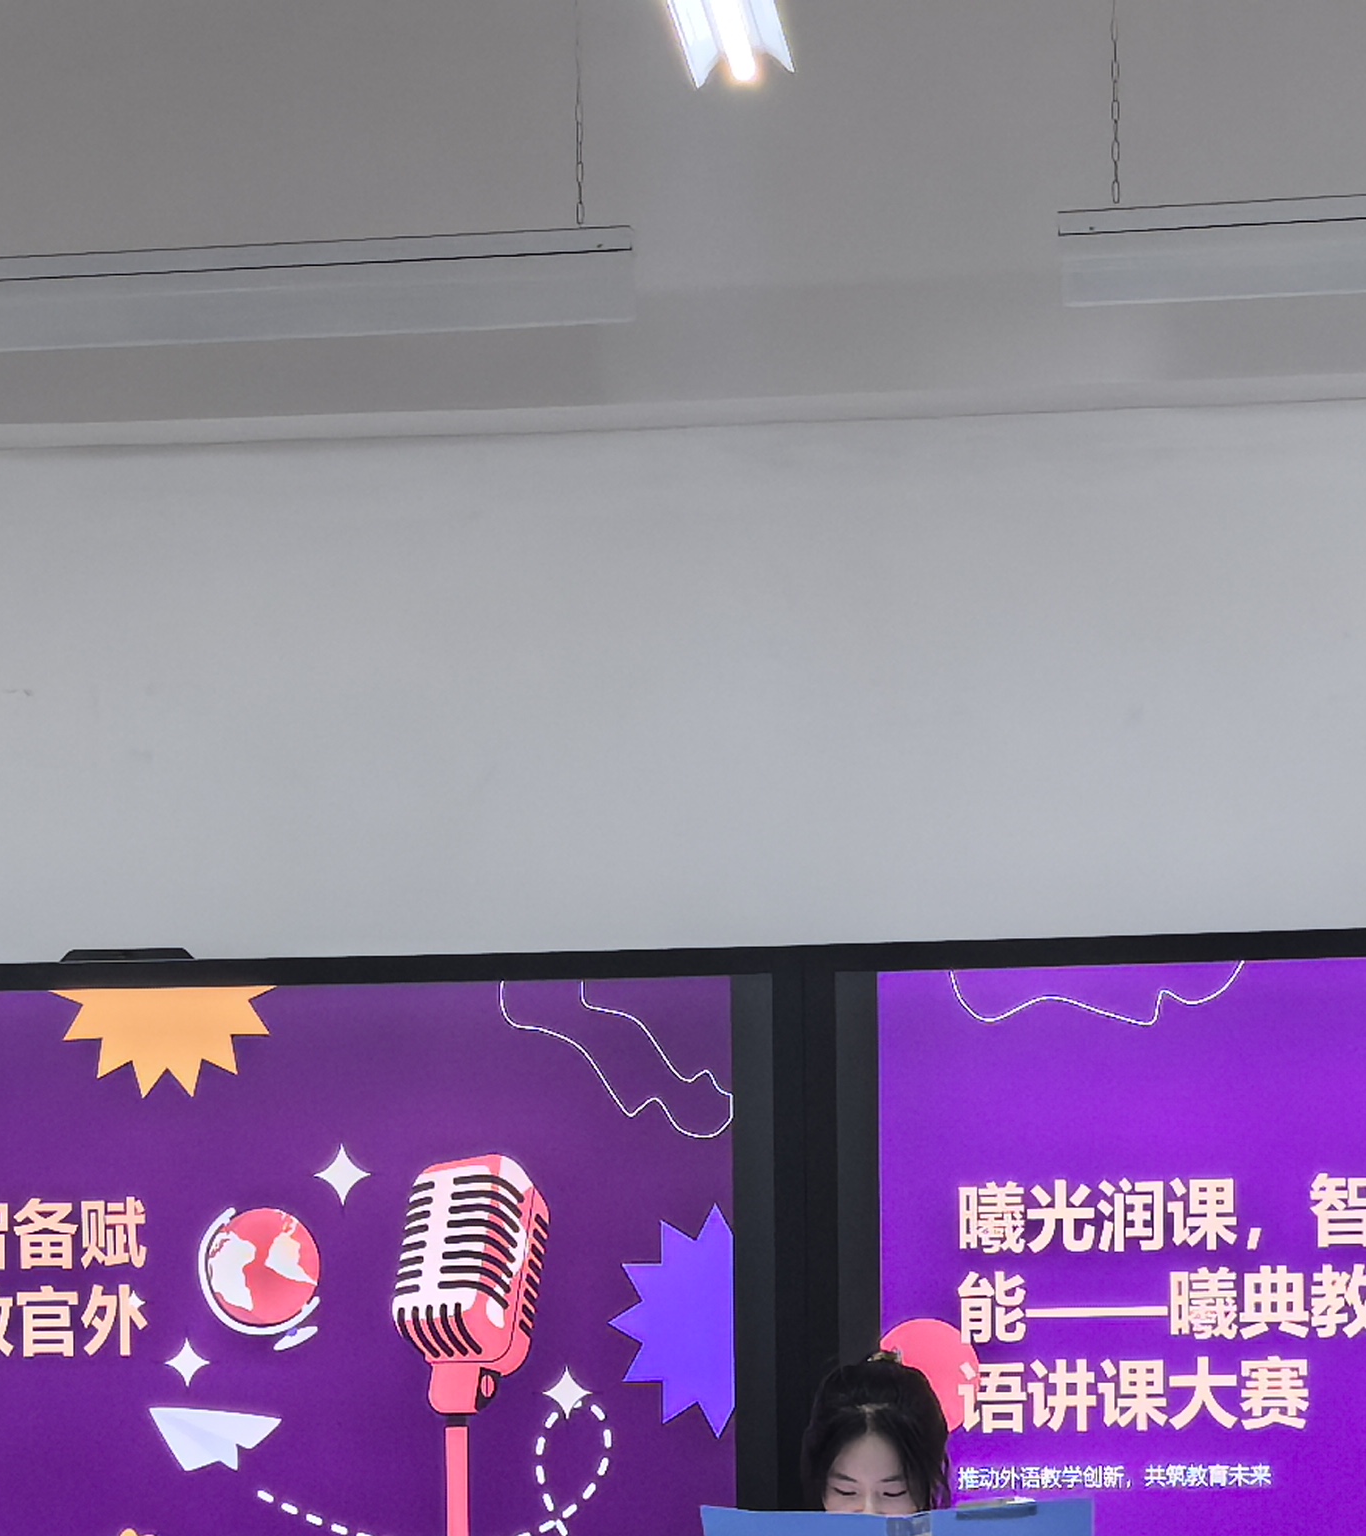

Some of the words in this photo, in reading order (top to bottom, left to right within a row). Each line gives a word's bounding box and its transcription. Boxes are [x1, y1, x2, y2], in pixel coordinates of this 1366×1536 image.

[957, 1355, 1310, 1434] 语讲课大赛
[957, 1463, 1273, 1490] 推动外语教学创新，共筑教育未来
